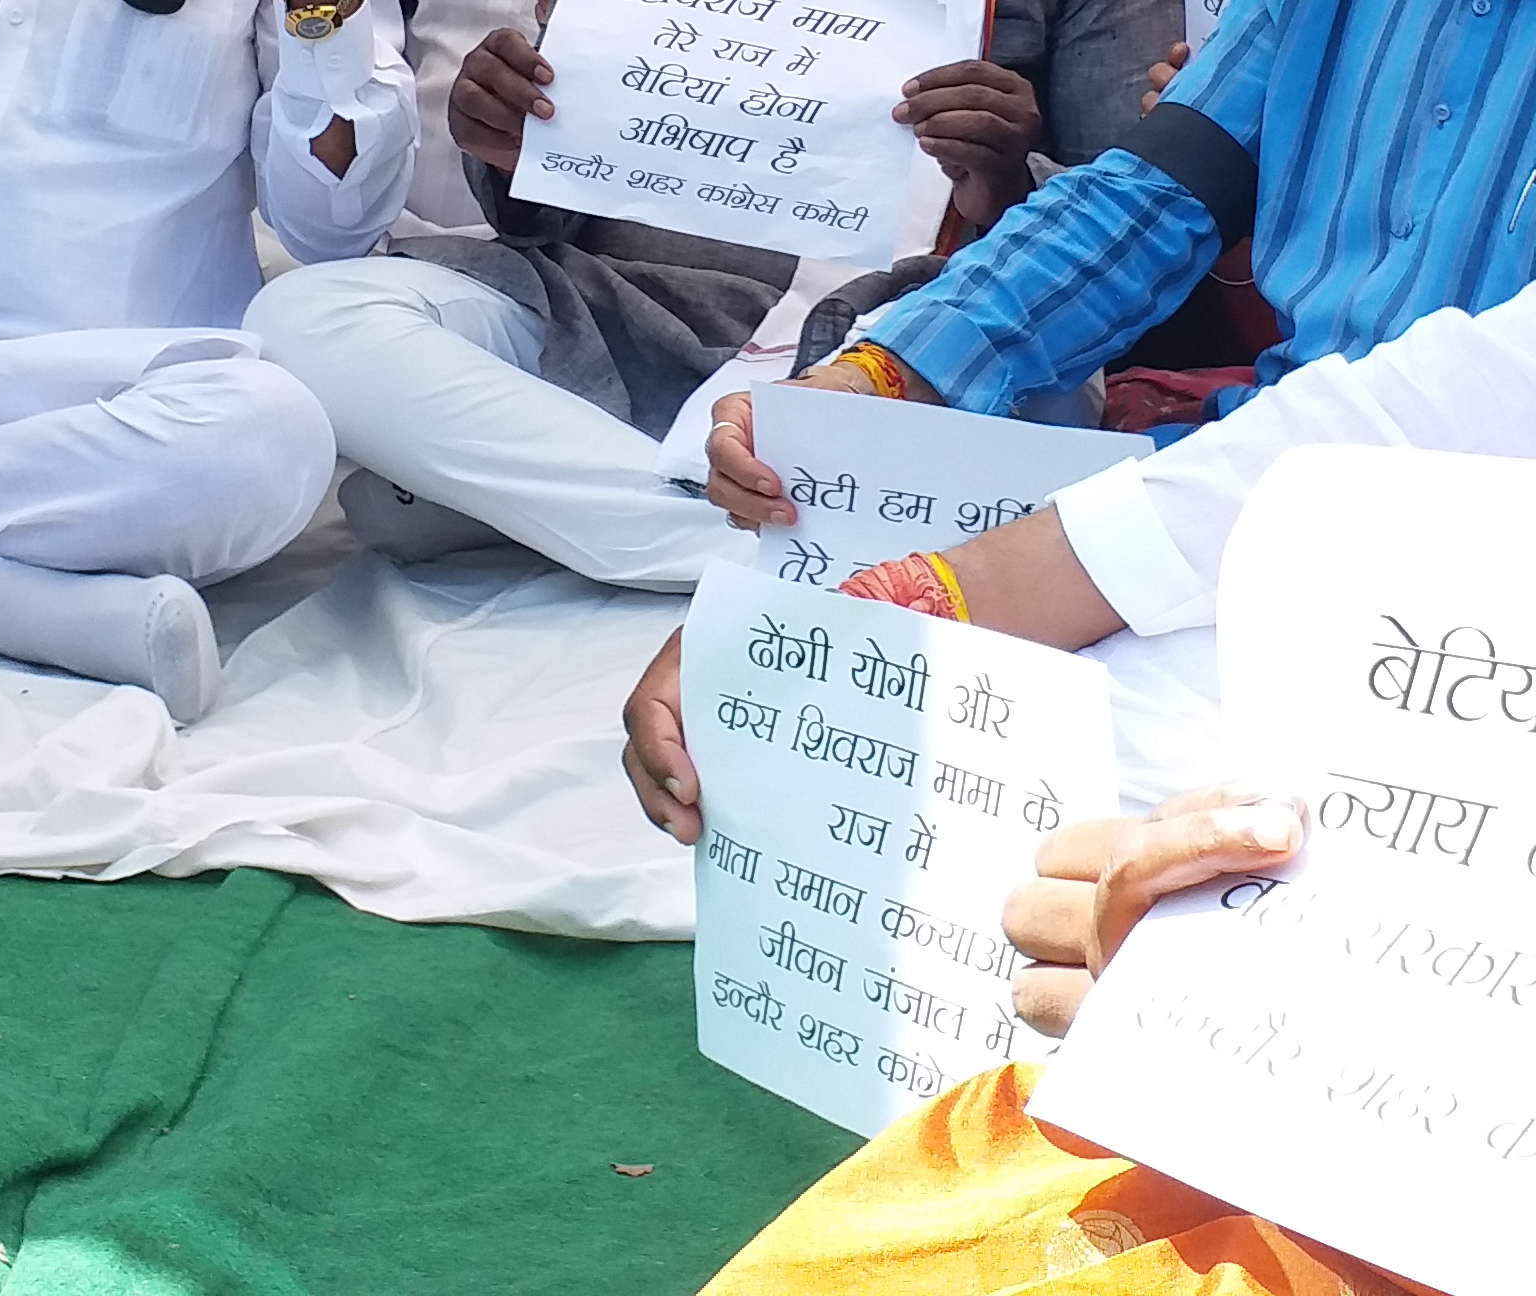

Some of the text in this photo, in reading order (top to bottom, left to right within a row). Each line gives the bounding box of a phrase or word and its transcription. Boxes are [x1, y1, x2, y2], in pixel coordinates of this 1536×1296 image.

[652, 18, 821, 76] तेरे राज में
[792, 5, 885, 43] मामा
[621, 56, 828, 125] बेटियां होना
[619, 113, 807, 175] अभिषाप है
[540, 150, 870, 233] इन्दौर शहर कांग्रेस कमेटी
[790, 466, 860, 513] बेटी
[878, 490, 938, 524] हम
[778, 538, 834, 586] तेरे
[748, 614, 1015, 740] ढोंगी योगी और
[716, 689, 1064, 834] कंस शिवराज मामा के
[826, 803, 938, 870] राज में
[1318, 771, 1498, 866] न्याय
[706, 828, 763, 885] माता
[775, 858, 867, 925] समान
[759, 923, 848, 994] जीवन
[863, 965, 970, 1040] जंजाल
[712, 969, 972, 1098] इन्दौर शहर कांग्रे
